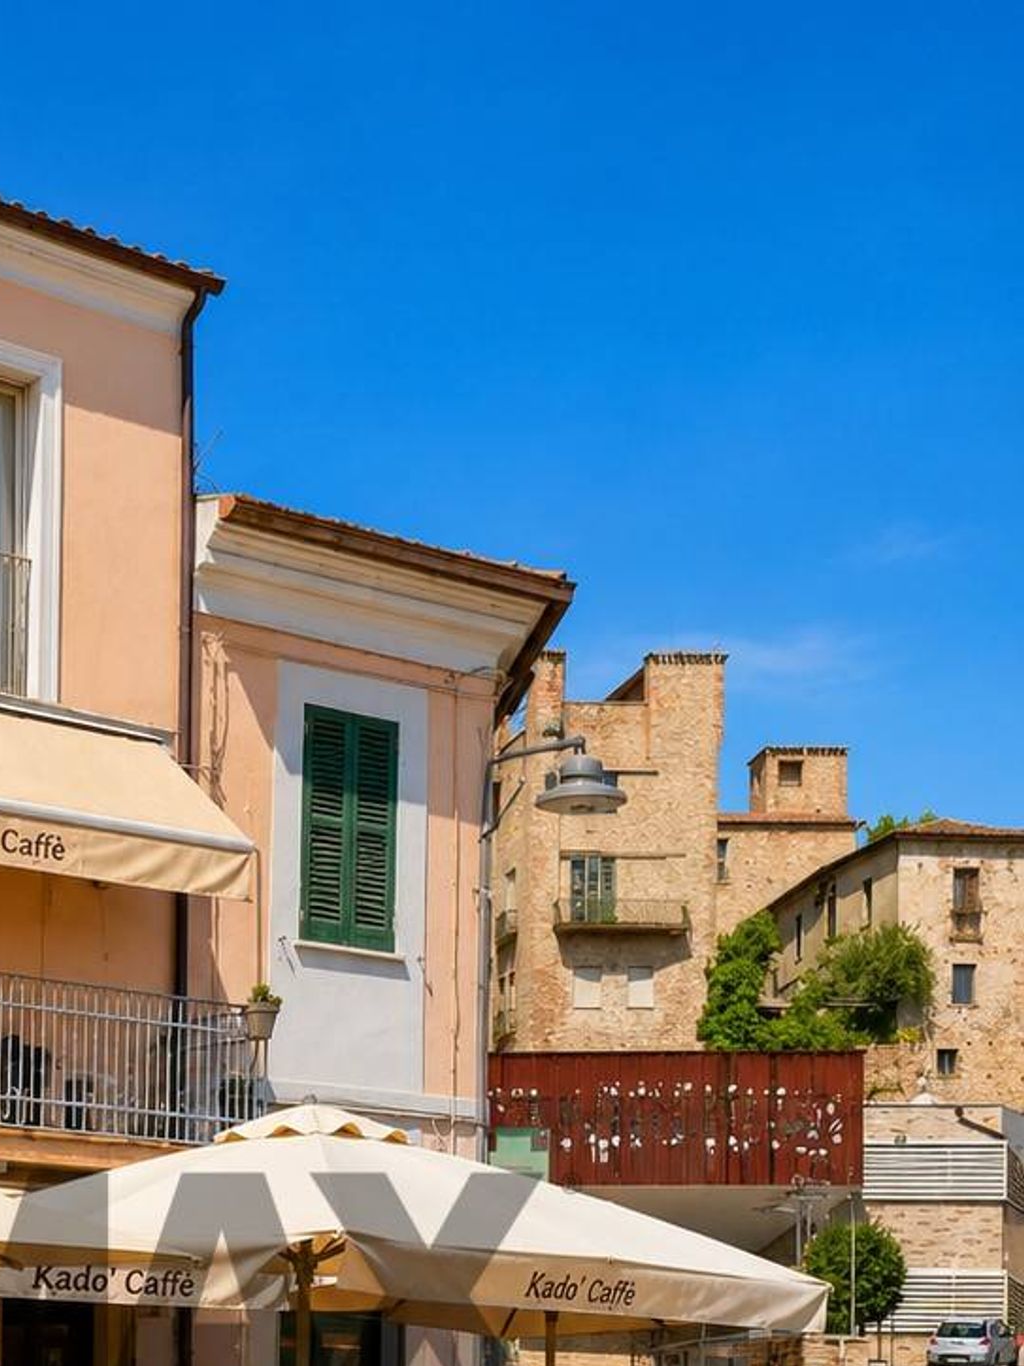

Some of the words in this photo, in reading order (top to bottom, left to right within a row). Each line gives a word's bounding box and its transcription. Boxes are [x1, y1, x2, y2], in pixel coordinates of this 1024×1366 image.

[1, 829, 65, 861] Caffè
[32, 1265, 116, 1292] Kado'
[125, 1270, 194, 1297] Caffè
[525, 1271, 586, 1301] Kado'
[588, 1279, 635, 1306] Caffè
